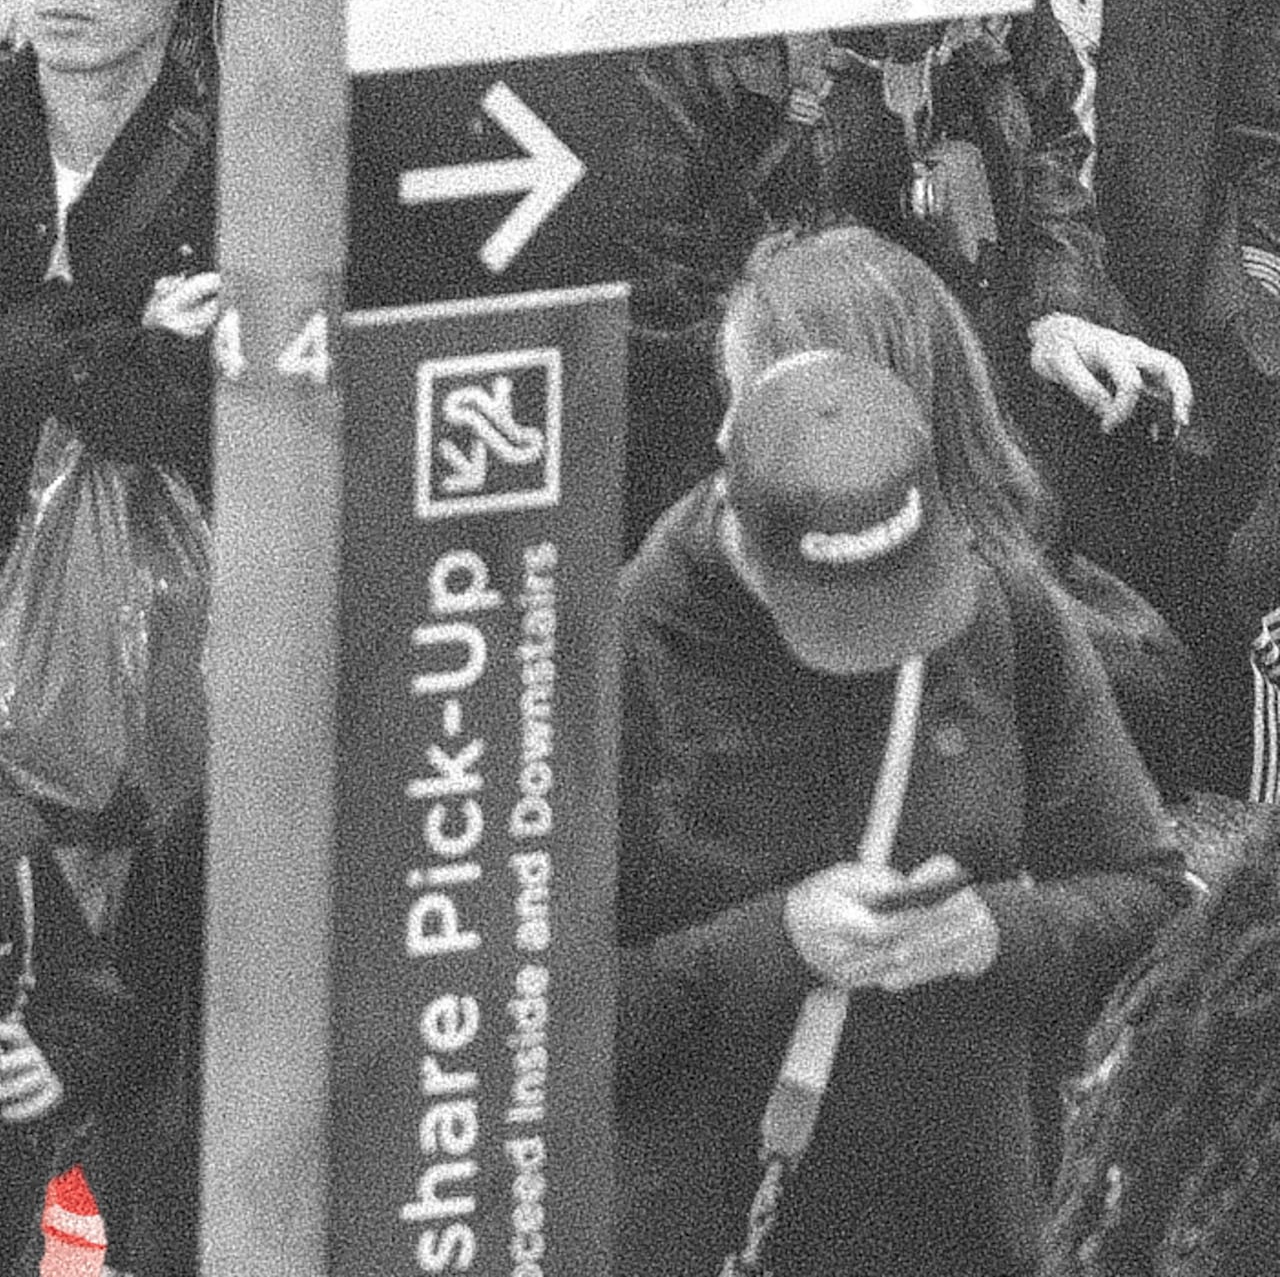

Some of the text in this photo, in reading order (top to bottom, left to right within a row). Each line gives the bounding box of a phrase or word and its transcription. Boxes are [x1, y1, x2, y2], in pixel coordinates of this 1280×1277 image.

[277, 309, 331, 385] 4
[508, 541, 559, 839] Downstairs
[400, 549, 503, 1273] share Pick-Up
[508, 851, 552, 951] and
[504, 964, 551, 1124] Inside
